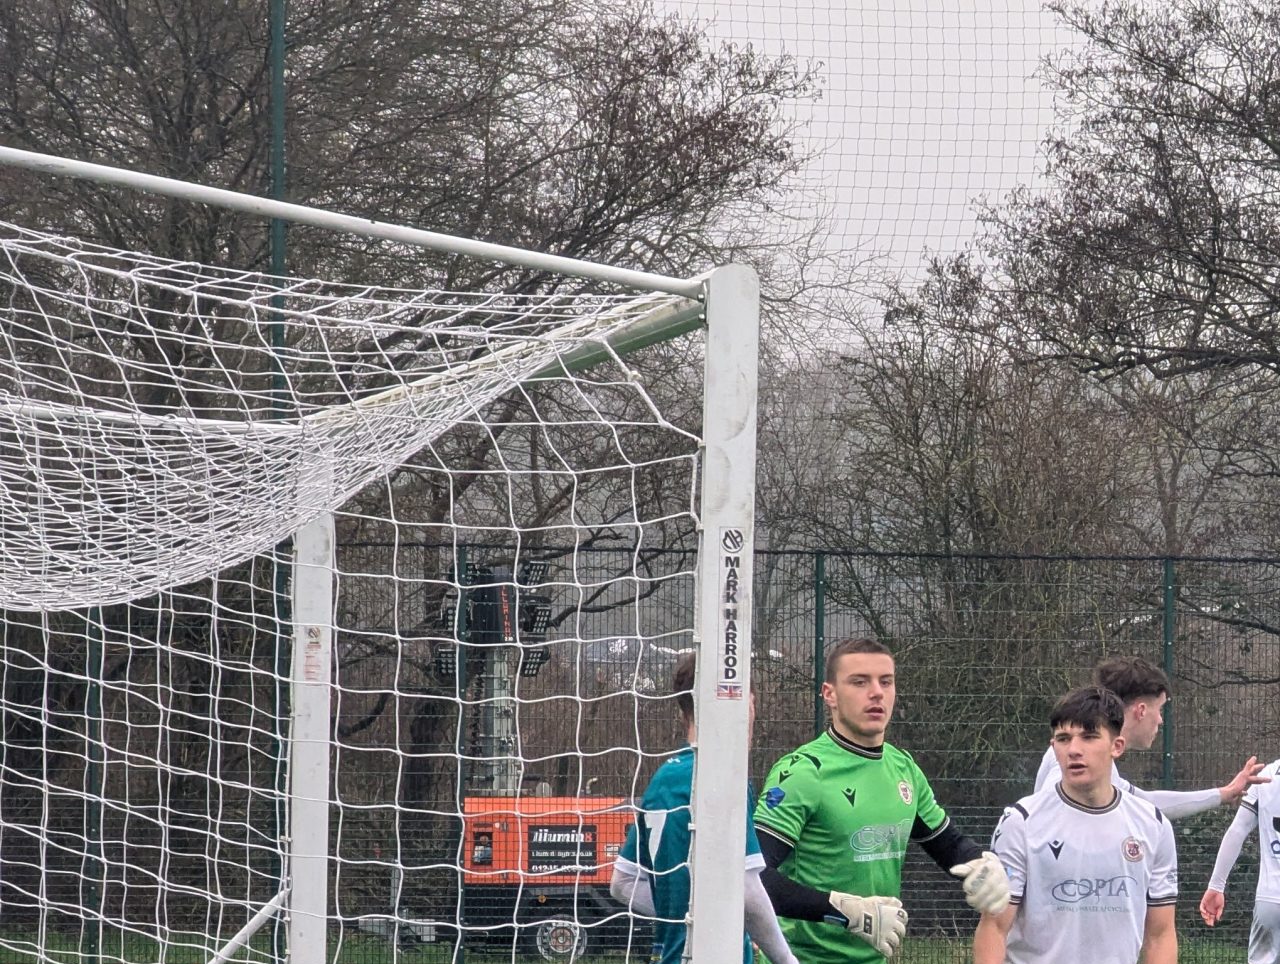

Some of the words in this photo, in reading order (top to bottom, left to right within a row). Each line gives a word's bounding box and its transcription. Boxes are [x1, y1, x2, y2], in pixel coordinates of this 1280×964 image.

[724, 556, 740, 604] MARK
[724, 608, 739, 680] HARROD
[643, 810, 667, 868] 7
[1056, 877, 1133, 901] COPIA
